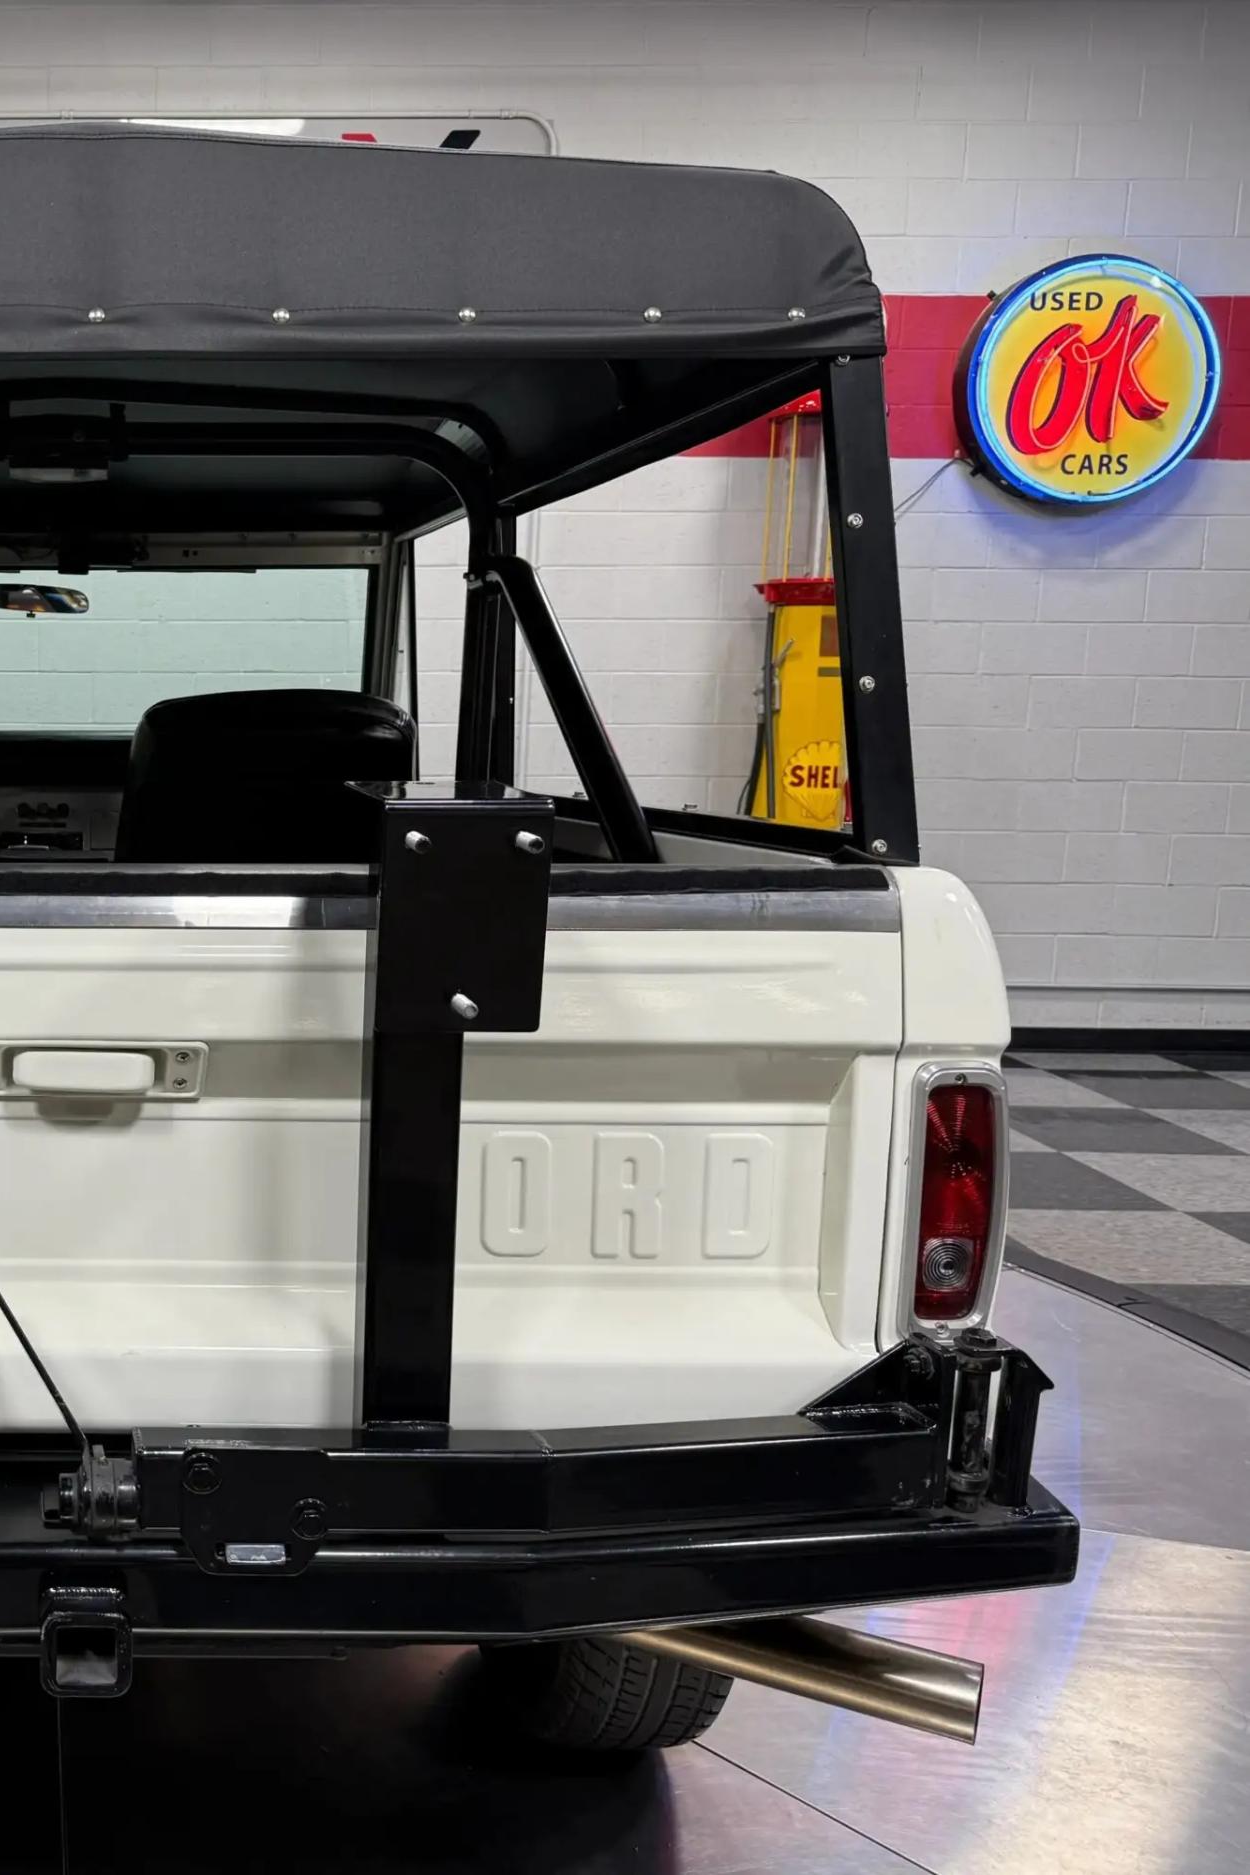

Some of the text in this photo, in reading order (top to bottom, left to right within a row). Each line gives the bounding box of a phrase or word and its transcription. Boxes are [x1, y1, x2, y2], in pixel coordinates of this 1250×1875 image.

[1030, 292, 1104, 312] USED
[1007, 294, 1169, 455] OK
[1060, 454, 1129, 475] CARS
